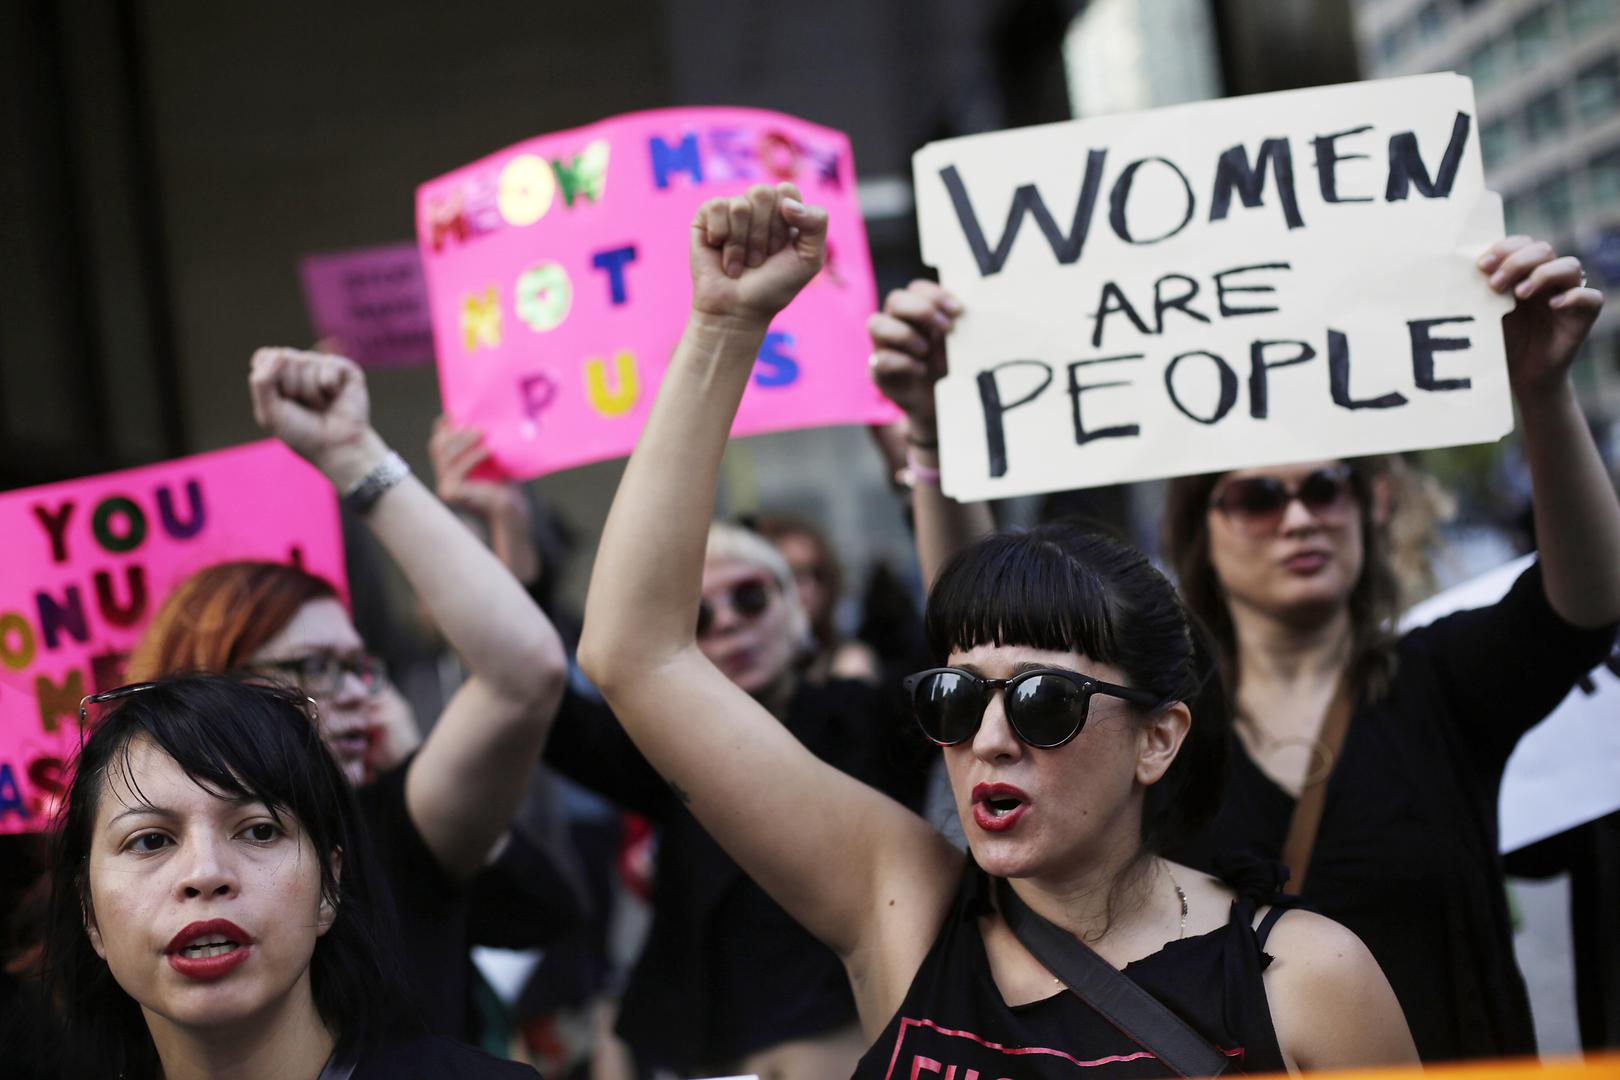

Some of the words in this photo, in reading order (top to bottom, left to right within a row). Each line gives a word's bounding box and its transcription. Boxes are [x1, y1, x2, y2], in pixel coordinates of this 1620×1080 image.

[940, 111, 1470, 277] WOMEN
[461, 245, 637, 351] NOT
[1088, 263, 1292, 348] ARE
[517, 332, 799, 418] PUS
[976, 316, 1474, 479] PEOPLE
[34, 481, 207, 563] YOU
